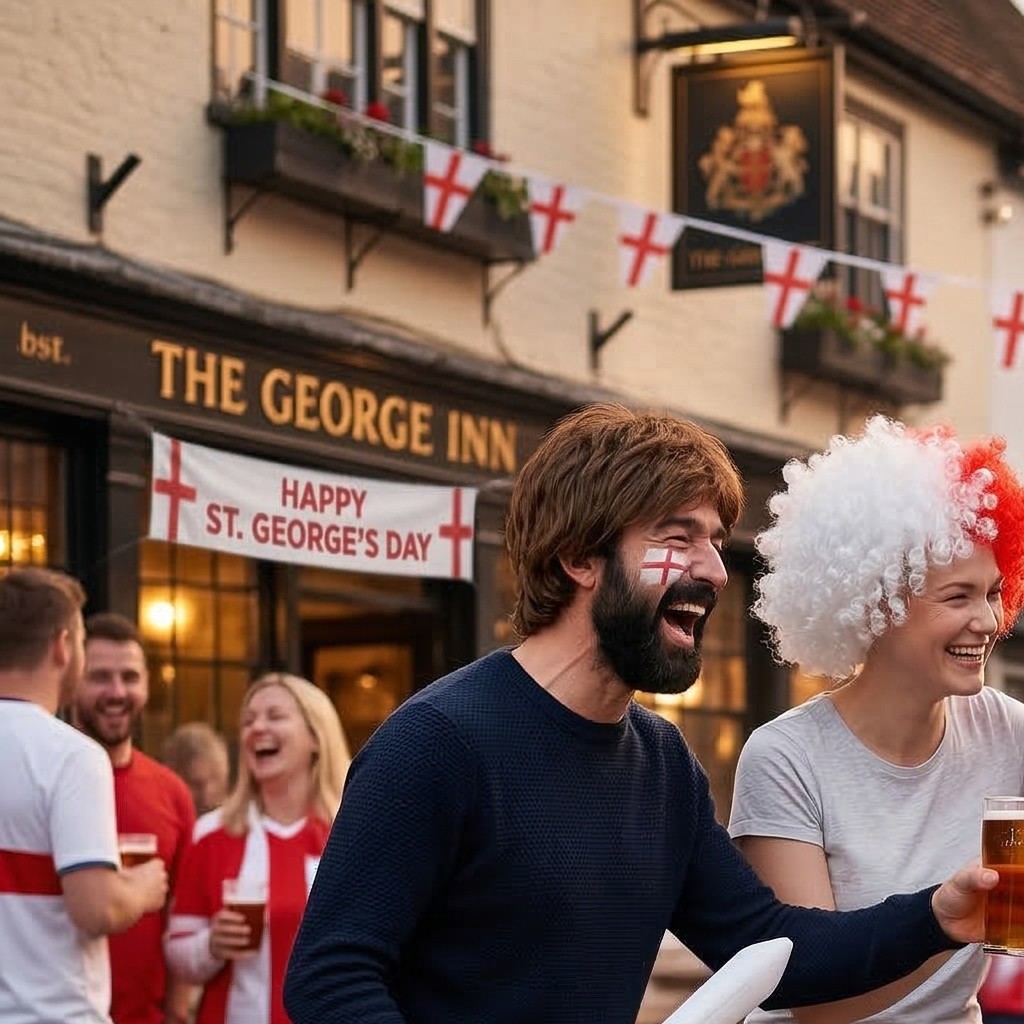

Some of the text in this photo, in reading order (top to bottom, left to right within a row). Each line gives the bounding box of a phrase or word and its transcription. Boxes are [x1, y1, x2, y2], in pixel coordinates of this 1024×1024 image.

[151, 340, 517, 472] THE GEORGE INN
[281, 477, 367, 518] HAPPY
[206, 504, 432, 561] ST. GEORGE’S DAY
